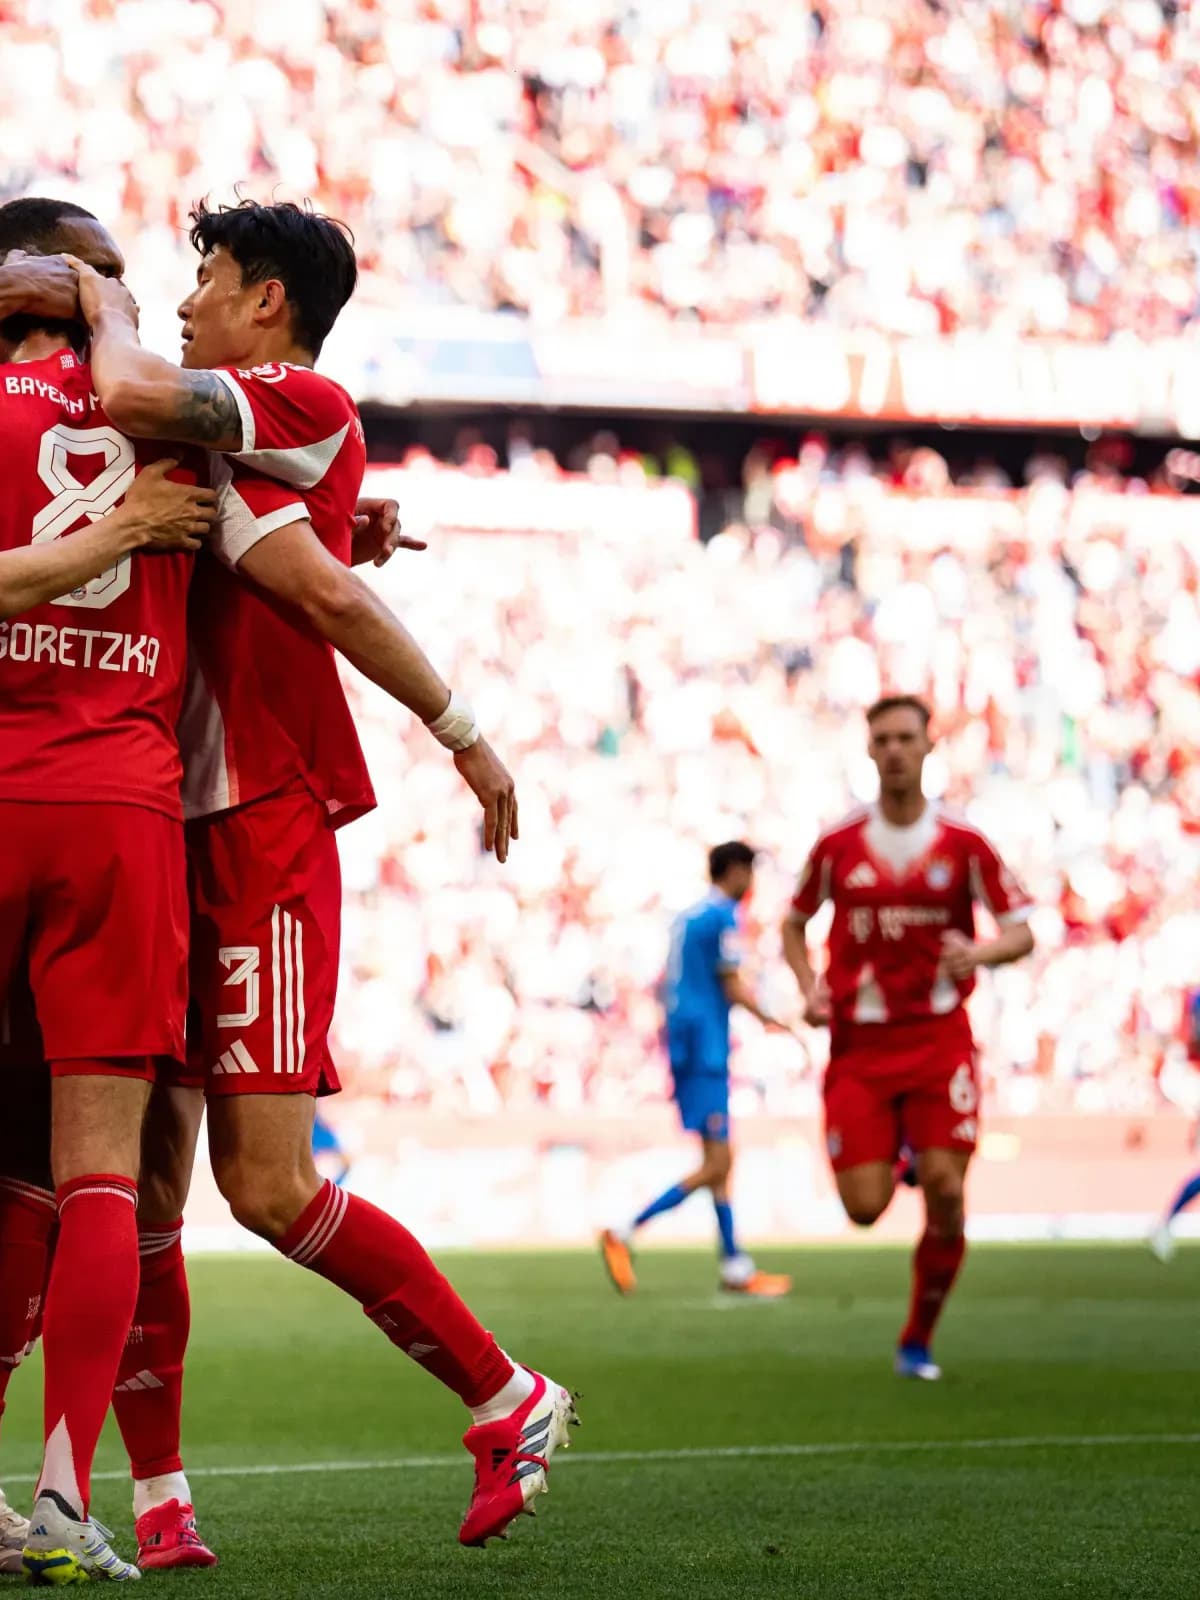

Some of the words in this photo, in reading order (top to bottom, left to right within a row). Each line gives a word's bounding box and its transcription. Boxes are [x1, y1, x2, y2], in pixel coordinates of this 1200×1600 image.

[5, 376, 85, 414] BAYERN
[31, 423, 136, 609] 8
[216, 946, 260, 1029] 3
[949, 1063, 977, 1114] 6
